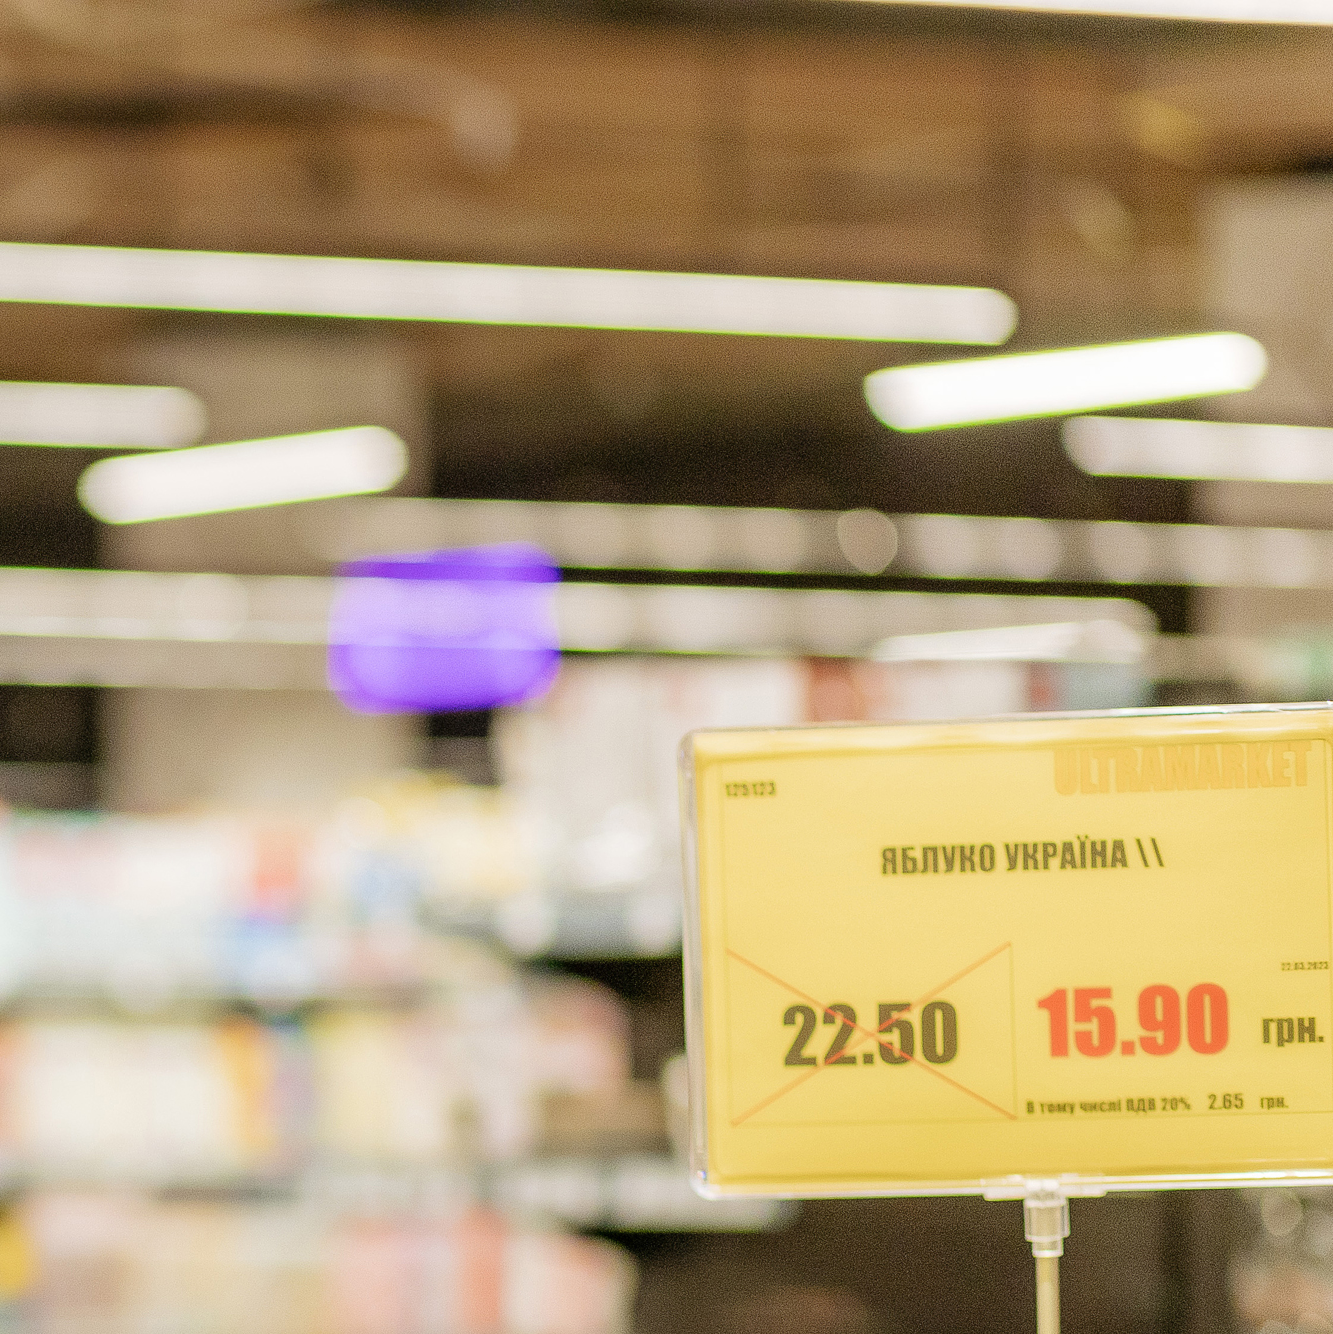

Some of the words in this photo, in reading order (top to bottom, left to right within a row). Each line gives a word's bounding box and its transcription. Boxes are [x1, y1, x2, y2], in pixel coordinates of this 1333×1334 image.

[1053, 739, 1312, 796] ULTRAMARKET
[882, 843, 995, 874] ЯБЛУКО
[1004, 835, 1128, 871] УКРАЇНА
[783, 1001, 958, 1066] 22.50
[1037, 983, 1230, 1058] 15.90
[1262, 1017, 1325, 1047] грн.
[1161, 1096, 1191, 1112] 20%
[1208, 1093, 1244, 1110] 2.65
[1259, 1096, 1289, 1110] грн.
